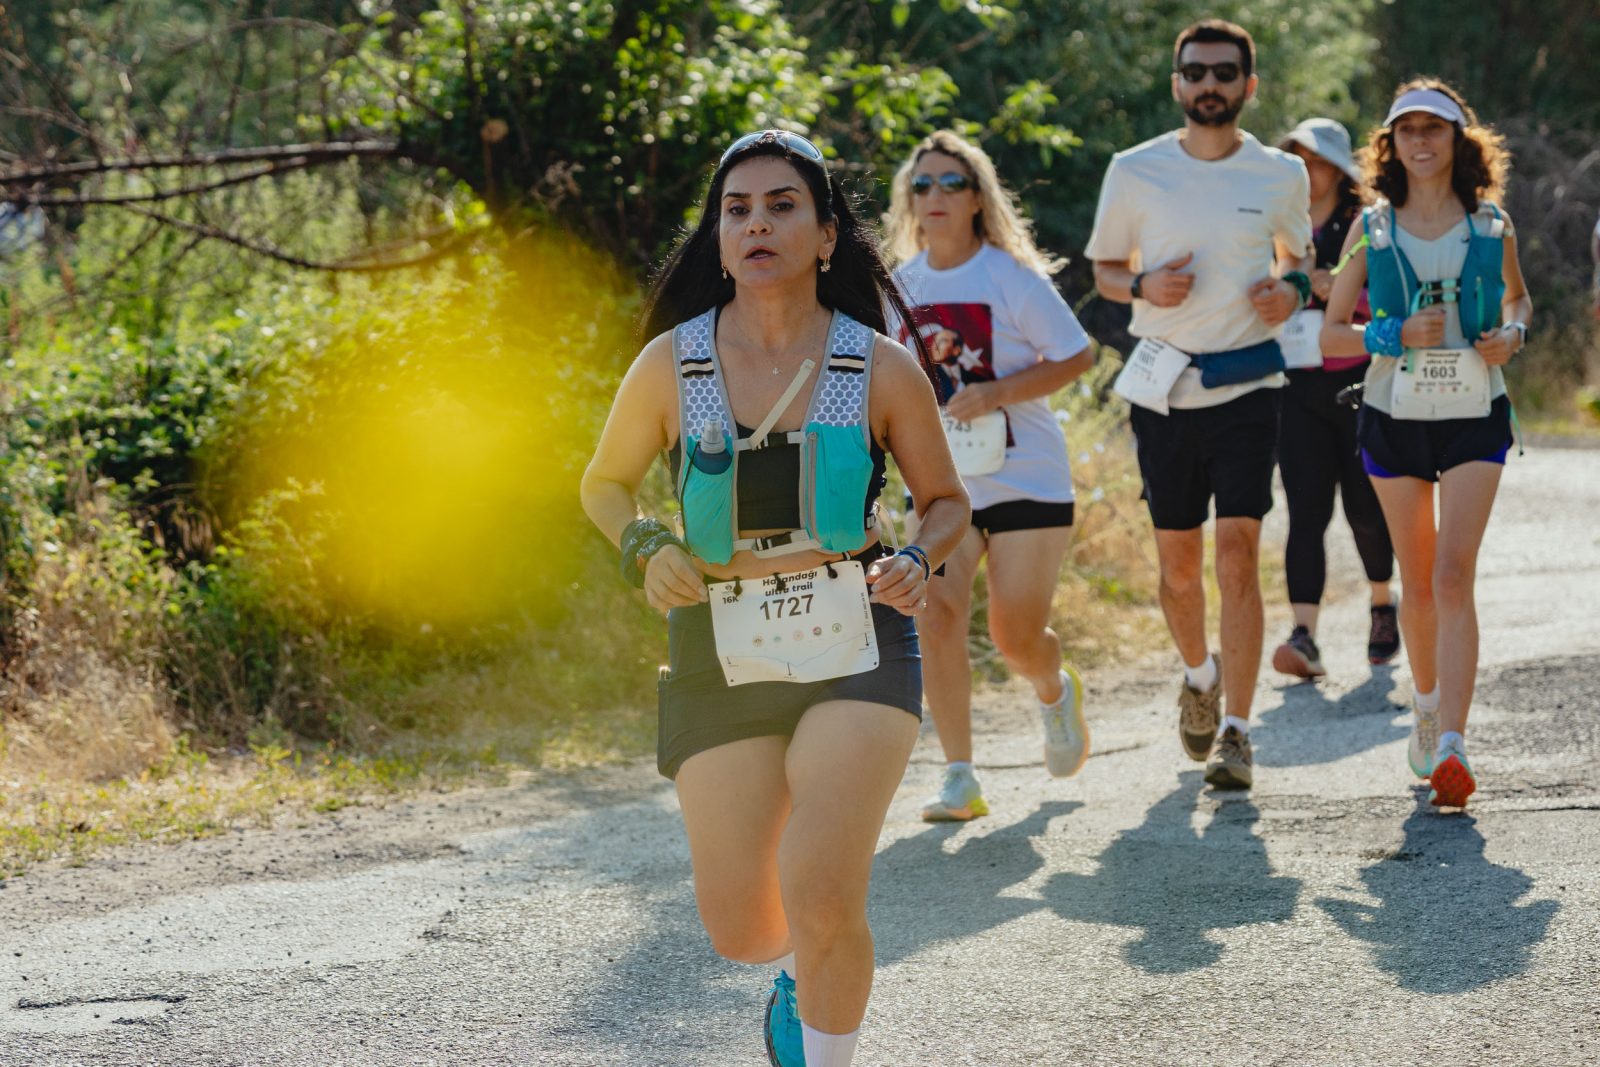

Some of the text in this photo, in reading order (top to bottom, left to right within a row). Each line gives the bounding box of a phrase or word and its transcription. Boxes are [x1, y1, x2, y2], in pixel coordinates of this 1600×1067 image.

[1422, 366, 1457, 379] 1603
[762, 570, 818, 587] Haandağı
[792, 581, 813, 592] trail
[722, 595, 739, 605] 16K
[760, 594, 814, 620] 1727
